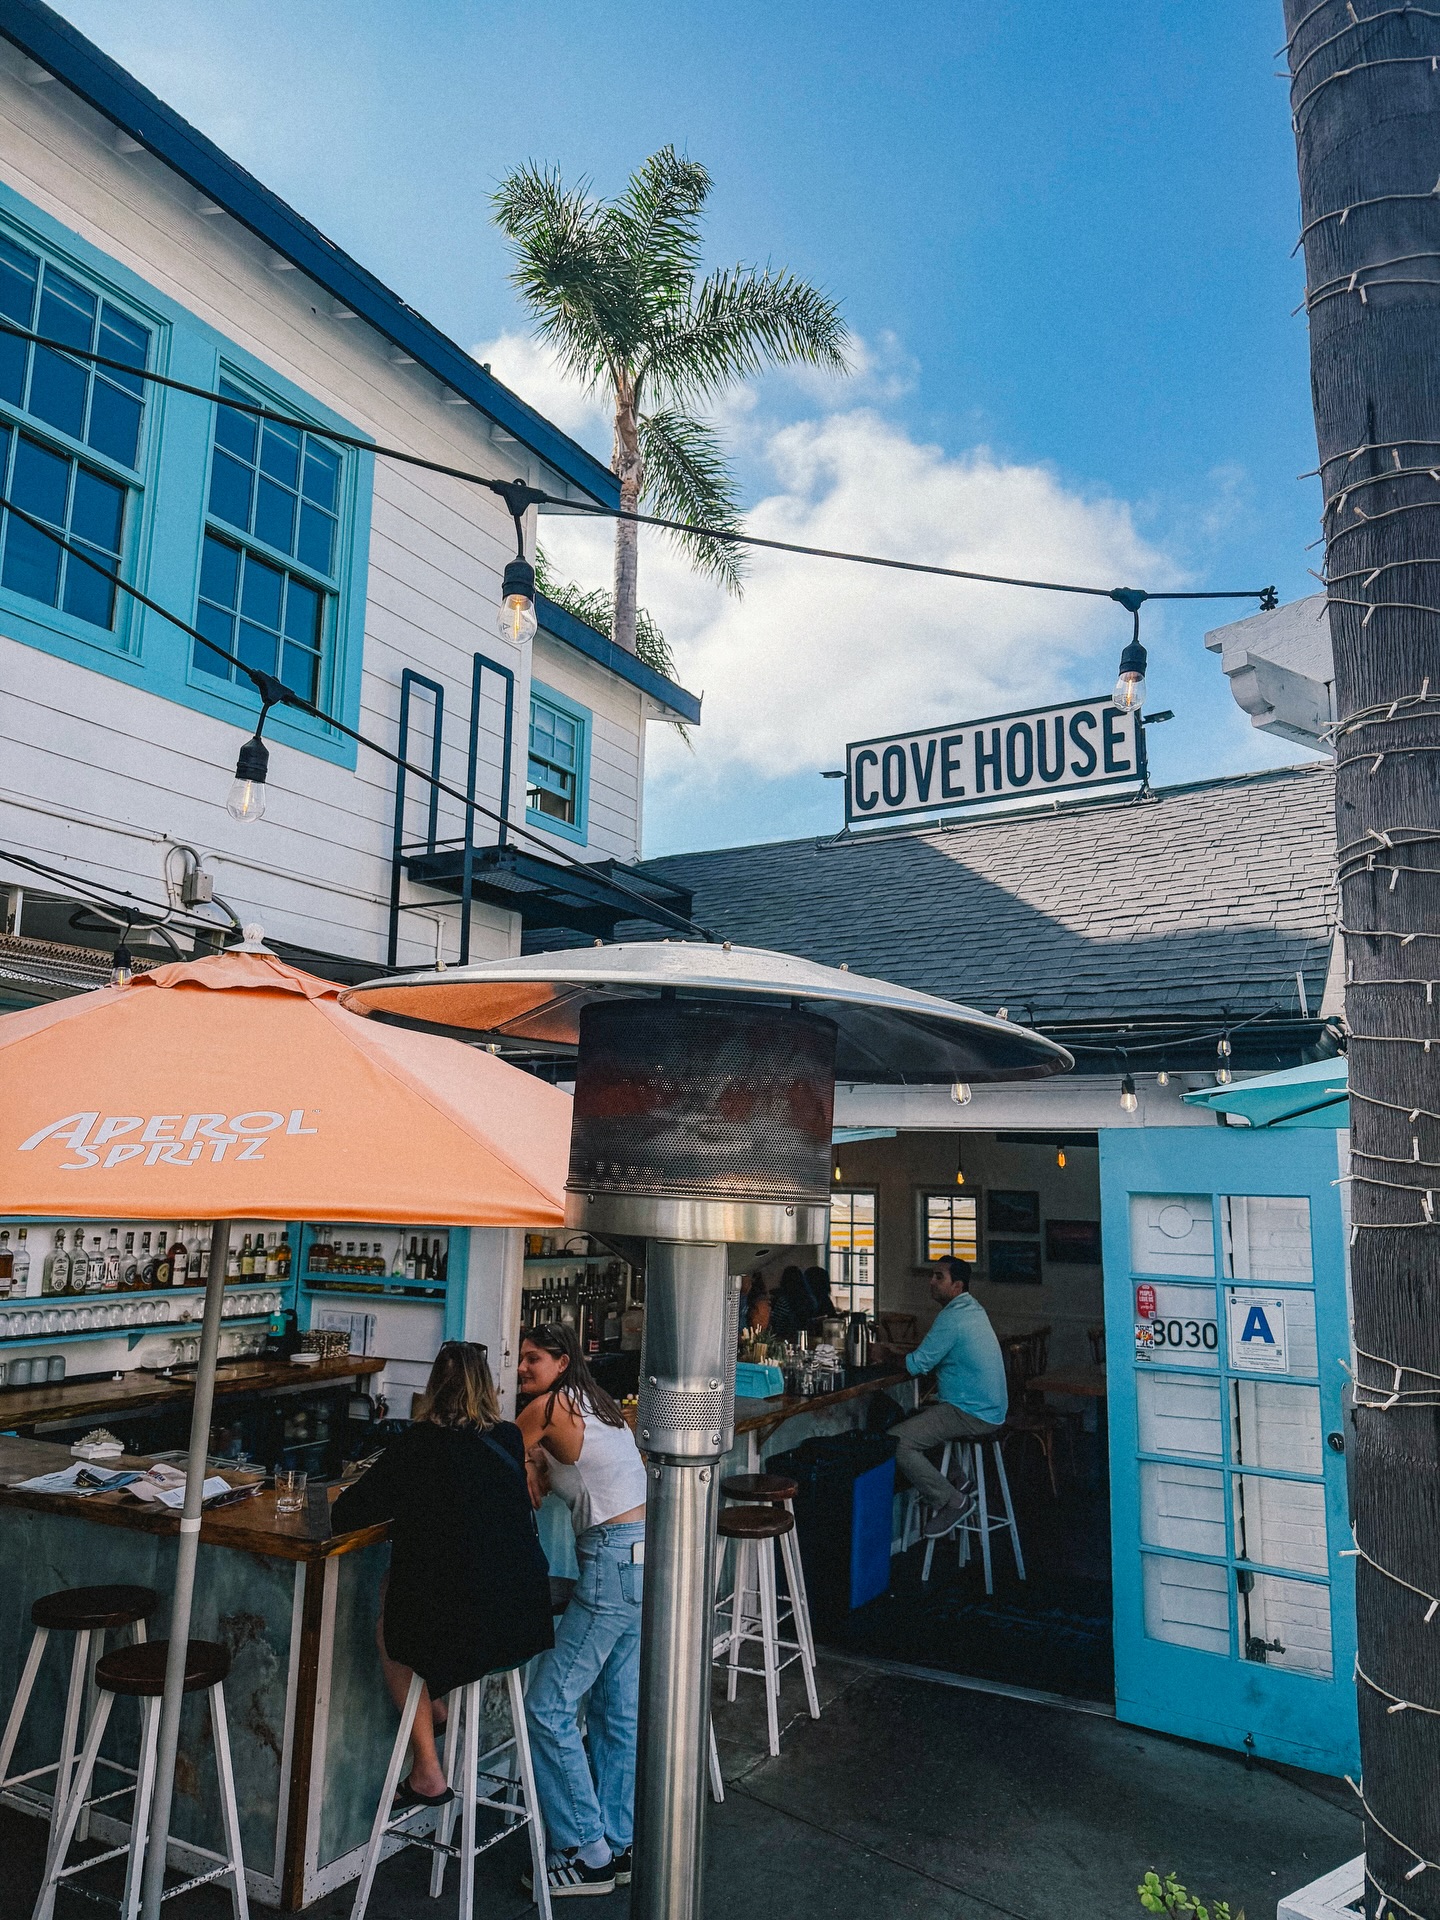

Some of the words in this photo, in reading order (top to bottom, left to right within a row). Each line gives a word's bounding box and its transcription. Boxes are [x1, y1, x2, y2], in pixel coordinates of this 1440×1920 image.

[855, 734, 965, 811] COVE
[975, 707, 1131, 793] HOUSE
[17, 1109, 318, 1151] APEROL
[1153, 1319, 1218, 1349] 8030
[1241, 1306, 1275, 1343] A
